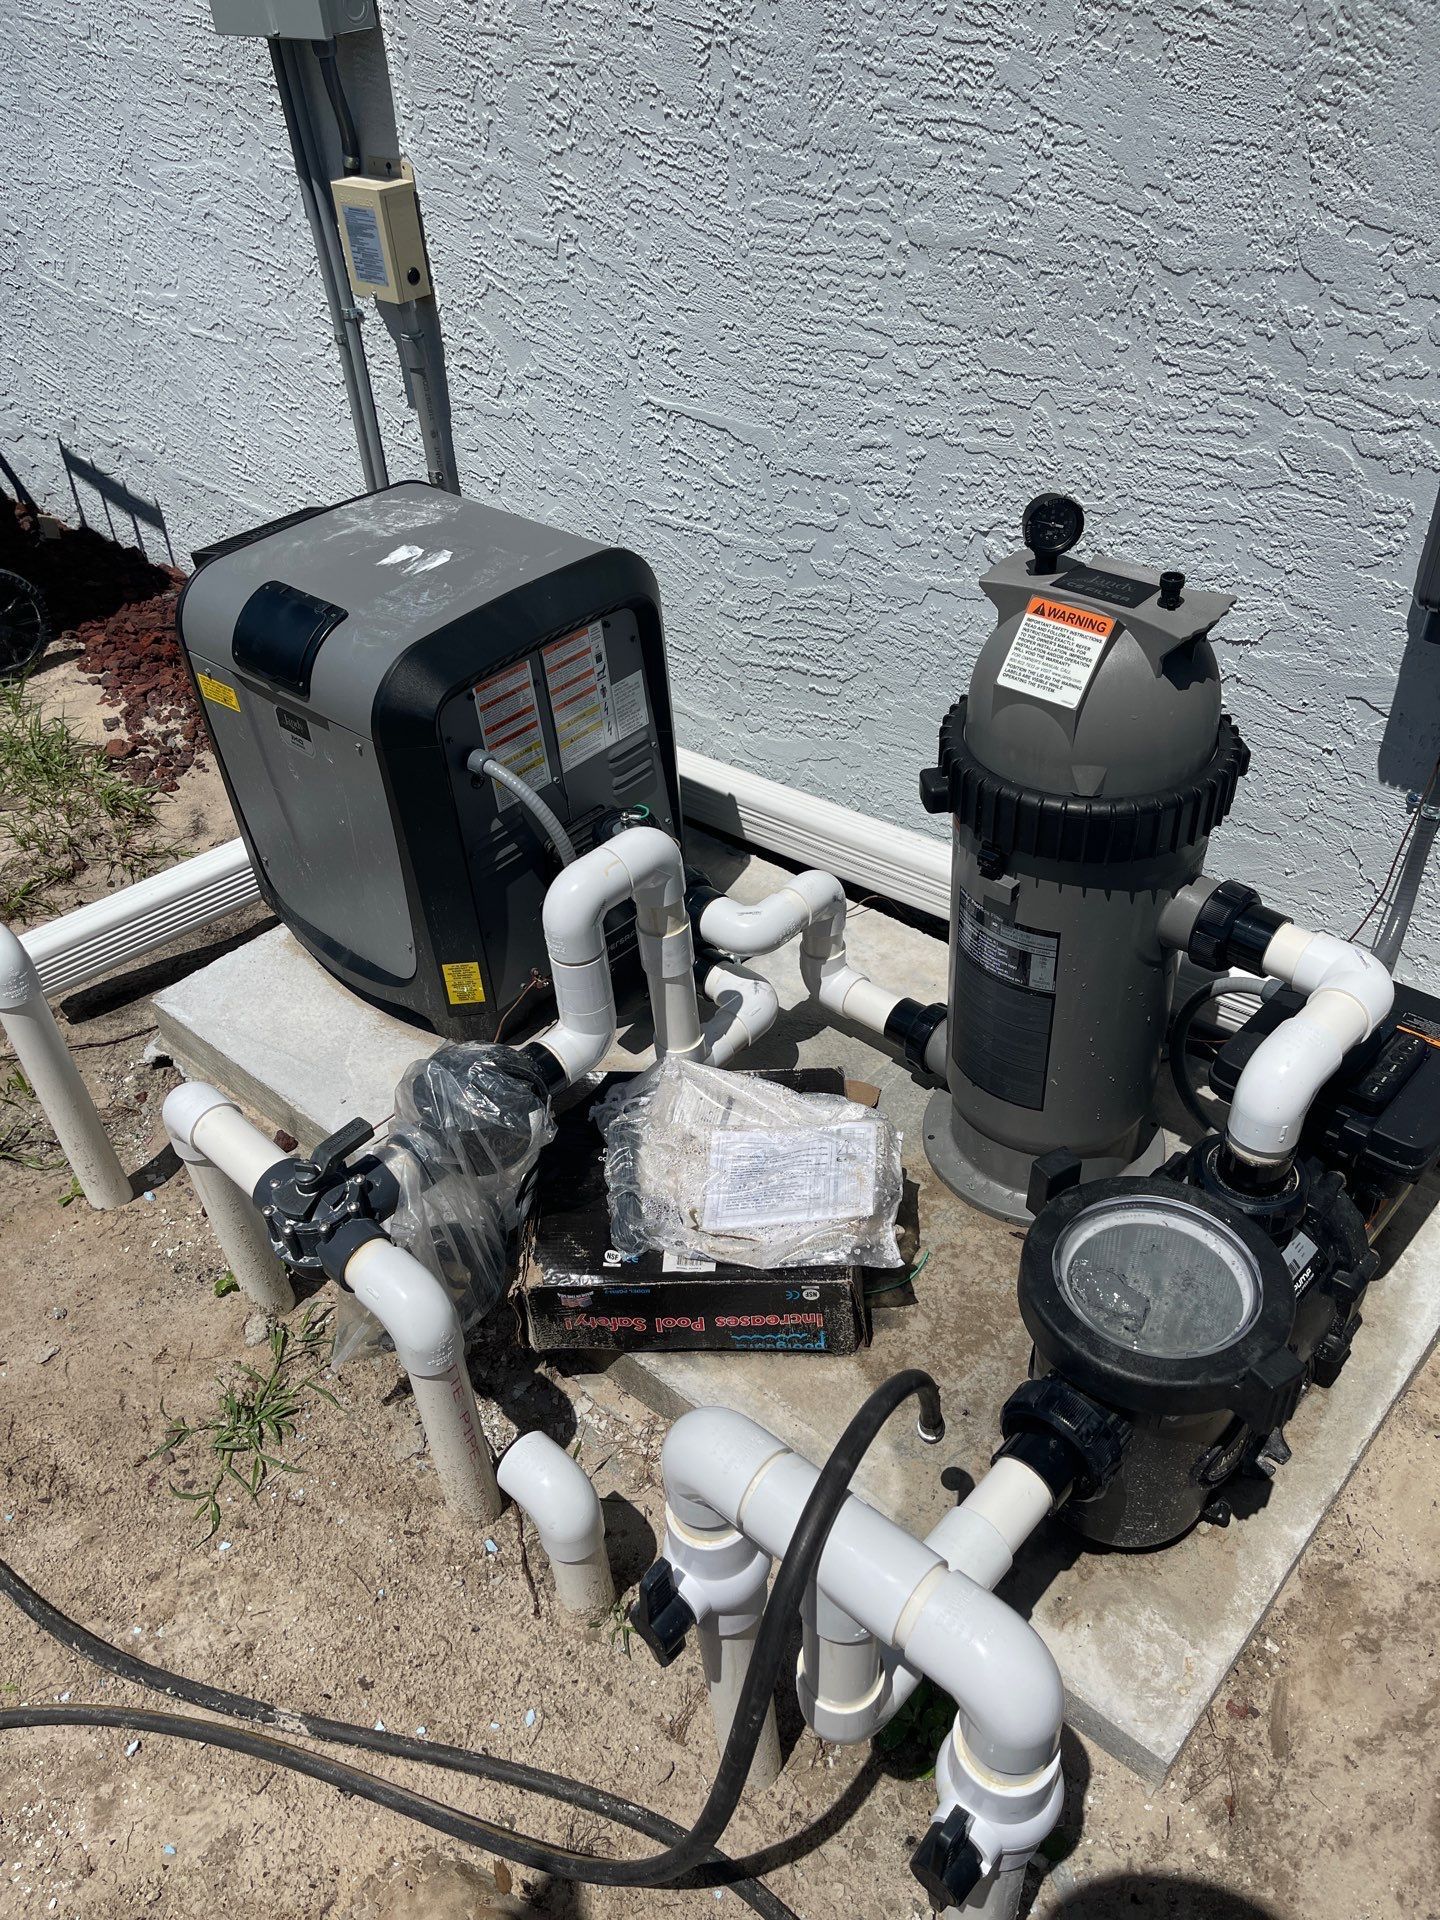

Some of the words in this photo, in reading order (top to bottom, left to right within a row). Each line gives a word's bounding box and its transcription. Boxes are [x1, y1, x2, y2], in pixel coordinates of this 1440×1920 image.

[1026, 617, 1051, 628] IMPORTANT
[1052, 625, 1068, 633] SAFETY
[1048, 607, 1108, 633] WARNING
[1022, 627, 1054, 640] INSTRUCTIONS
[1047, 629, 1066, 638] FOLLOW
[1016, 641, 1046, 654] INSTALLATION
[1064, 656, 1090, 668] OPERATION
[1018, 637, 1036, 645] PROPER
[1069, 652, 1092, 663] IMPROPER
[1057, 643, 1075, 652] MANUAL
[1002, 672, 1027, 683] OPERATING
[1004, 668, 1021, 676] LABELS
[1032, 676, 1048, 685] VISIBLE
[1007, 663, 1027, 672] POSITION
[1061, 680, 1082, 690] WARNING
[606, 1251, 619, 1261] NSF
[564, 1313, 647, 1332] Safety!
[655, 1317, 706, 1333] Pool
[714, 1312, 824, 1328] Increases
[460, 1410, 481, 1464] PIPE
